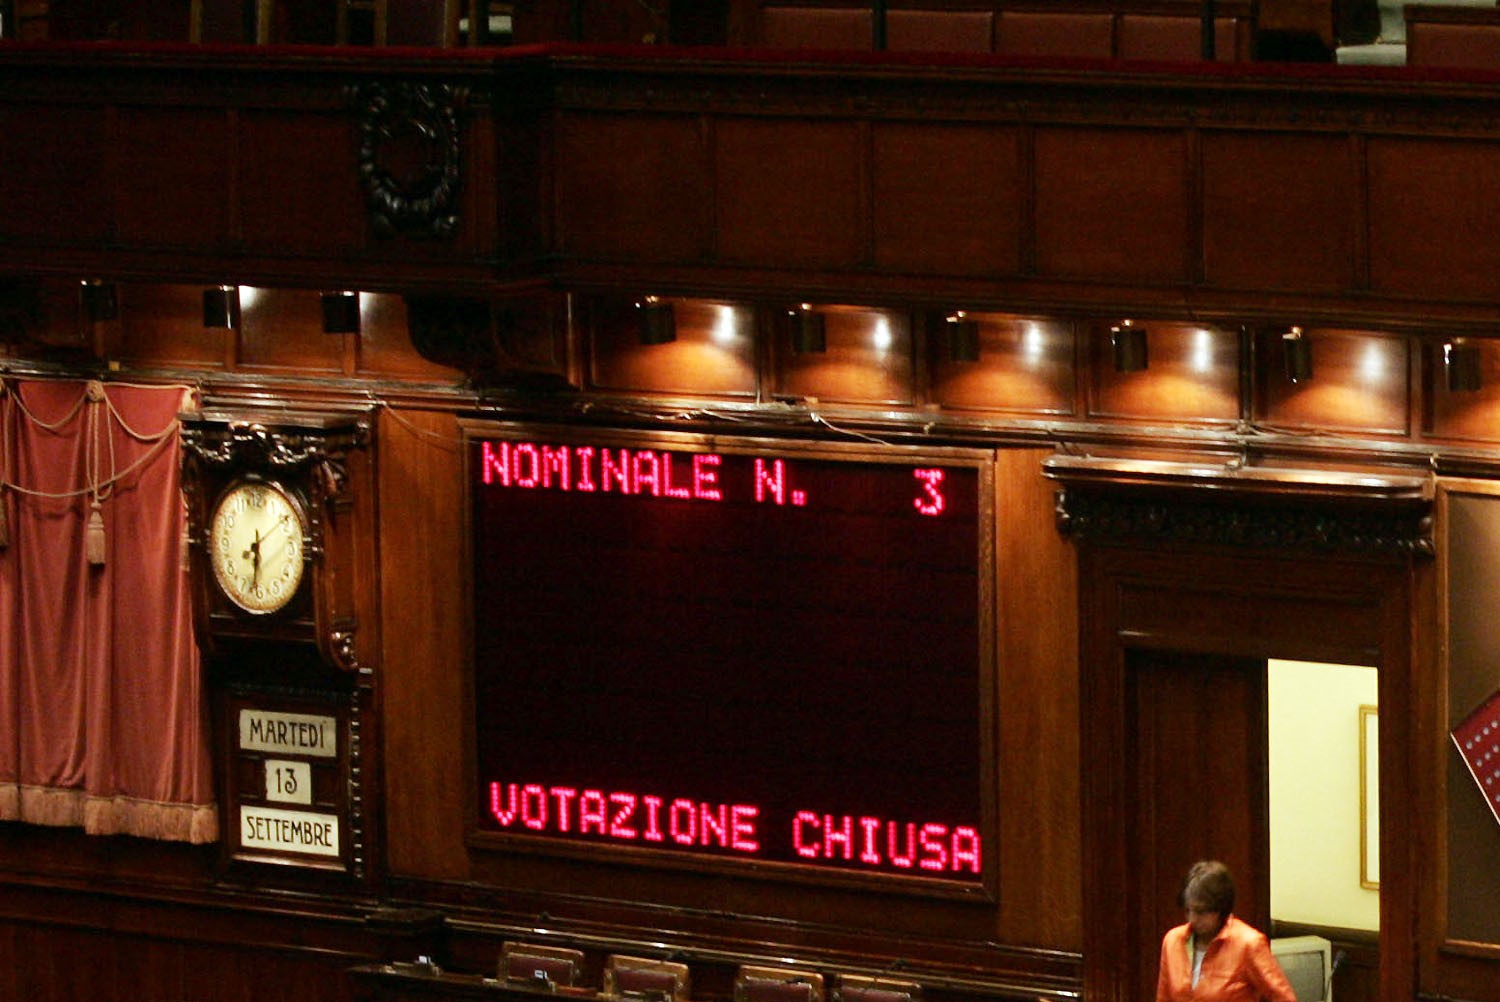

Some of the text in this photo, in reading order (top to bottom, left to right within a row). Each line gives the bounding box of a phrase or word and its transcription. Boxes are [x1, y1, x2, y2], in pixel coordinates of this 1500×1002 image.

[482, 441, 946, 516] NOMINALE N. 3
[276, 768, 298, 794] 13
[246, 816, 333, 847] SETTEMBRE
[490, 781, 982, 873] VOTAZIONE CHIUSA
